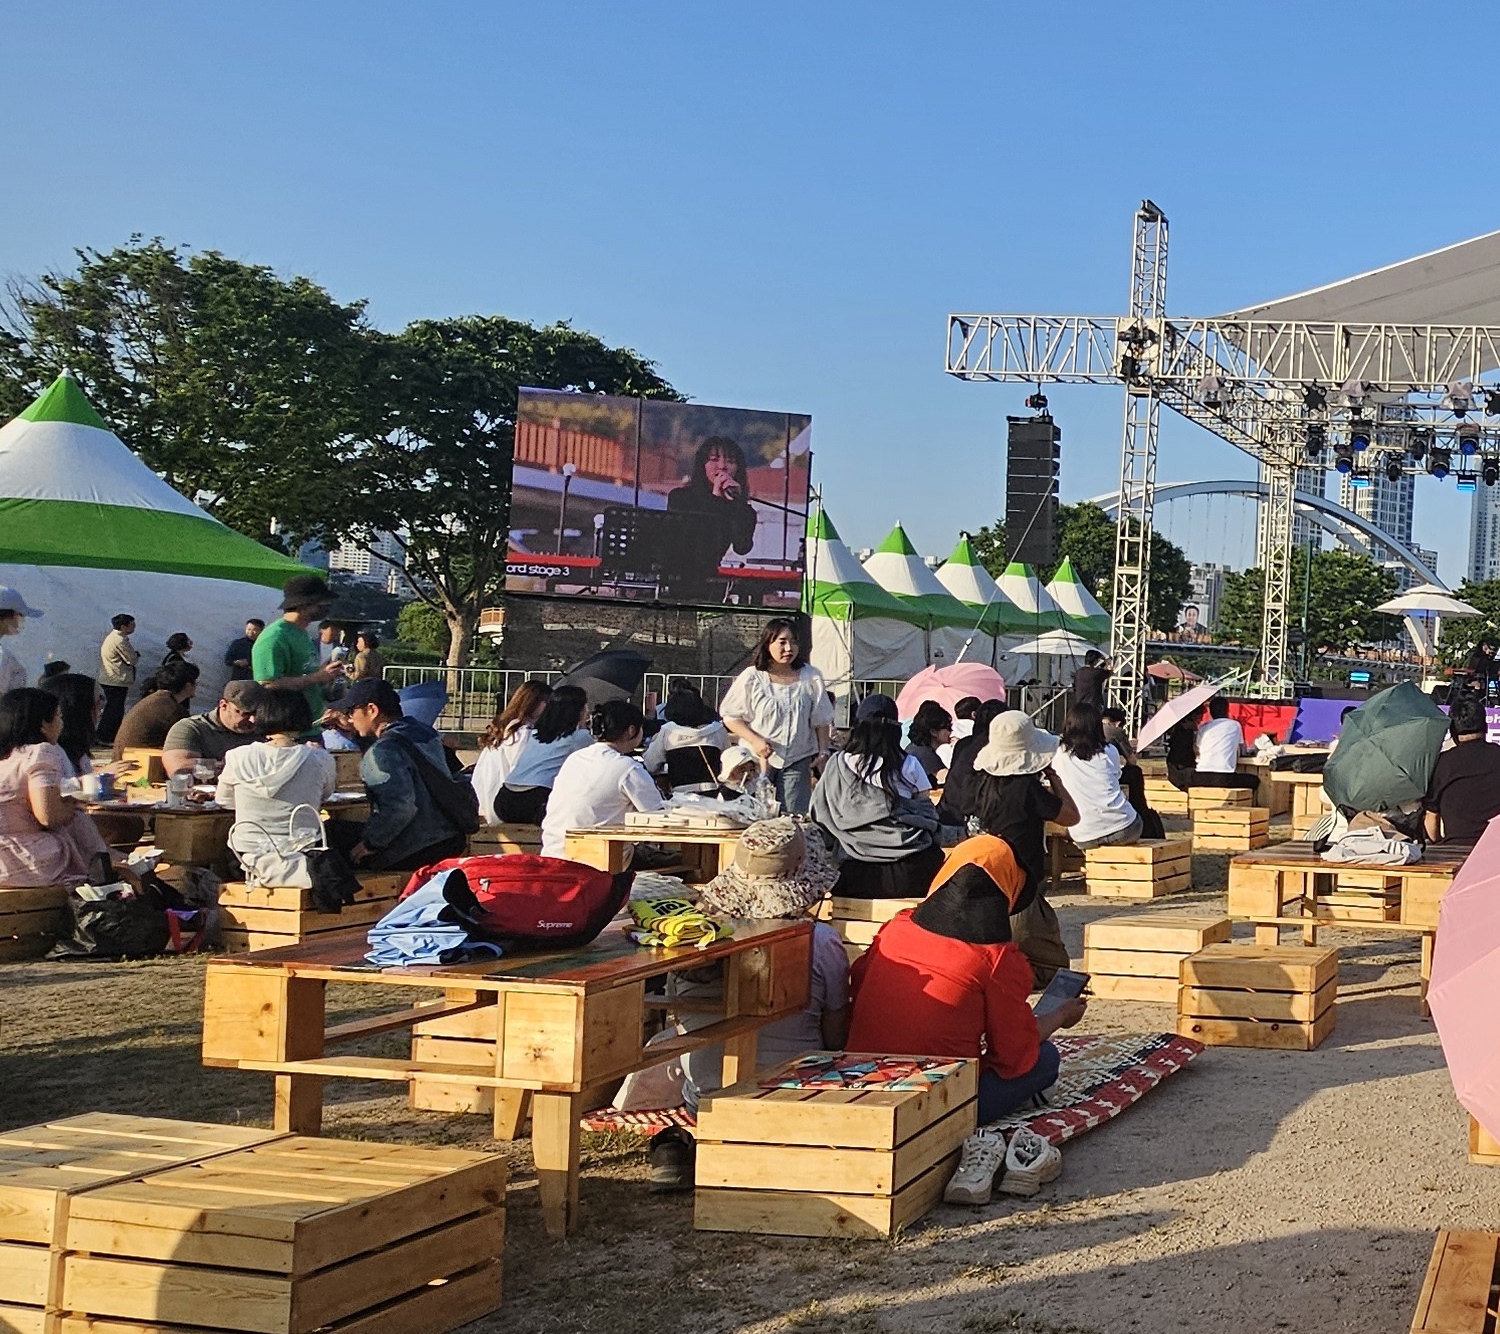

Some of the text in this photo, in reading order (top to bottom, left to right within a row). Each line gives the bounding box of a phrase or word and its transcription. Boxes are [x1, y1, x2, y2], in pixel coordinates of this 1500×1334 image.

[528, 565, 562, 577] stage
[562, 566, 570, 576] 3
[536, 919, 574, 931] Supreme
